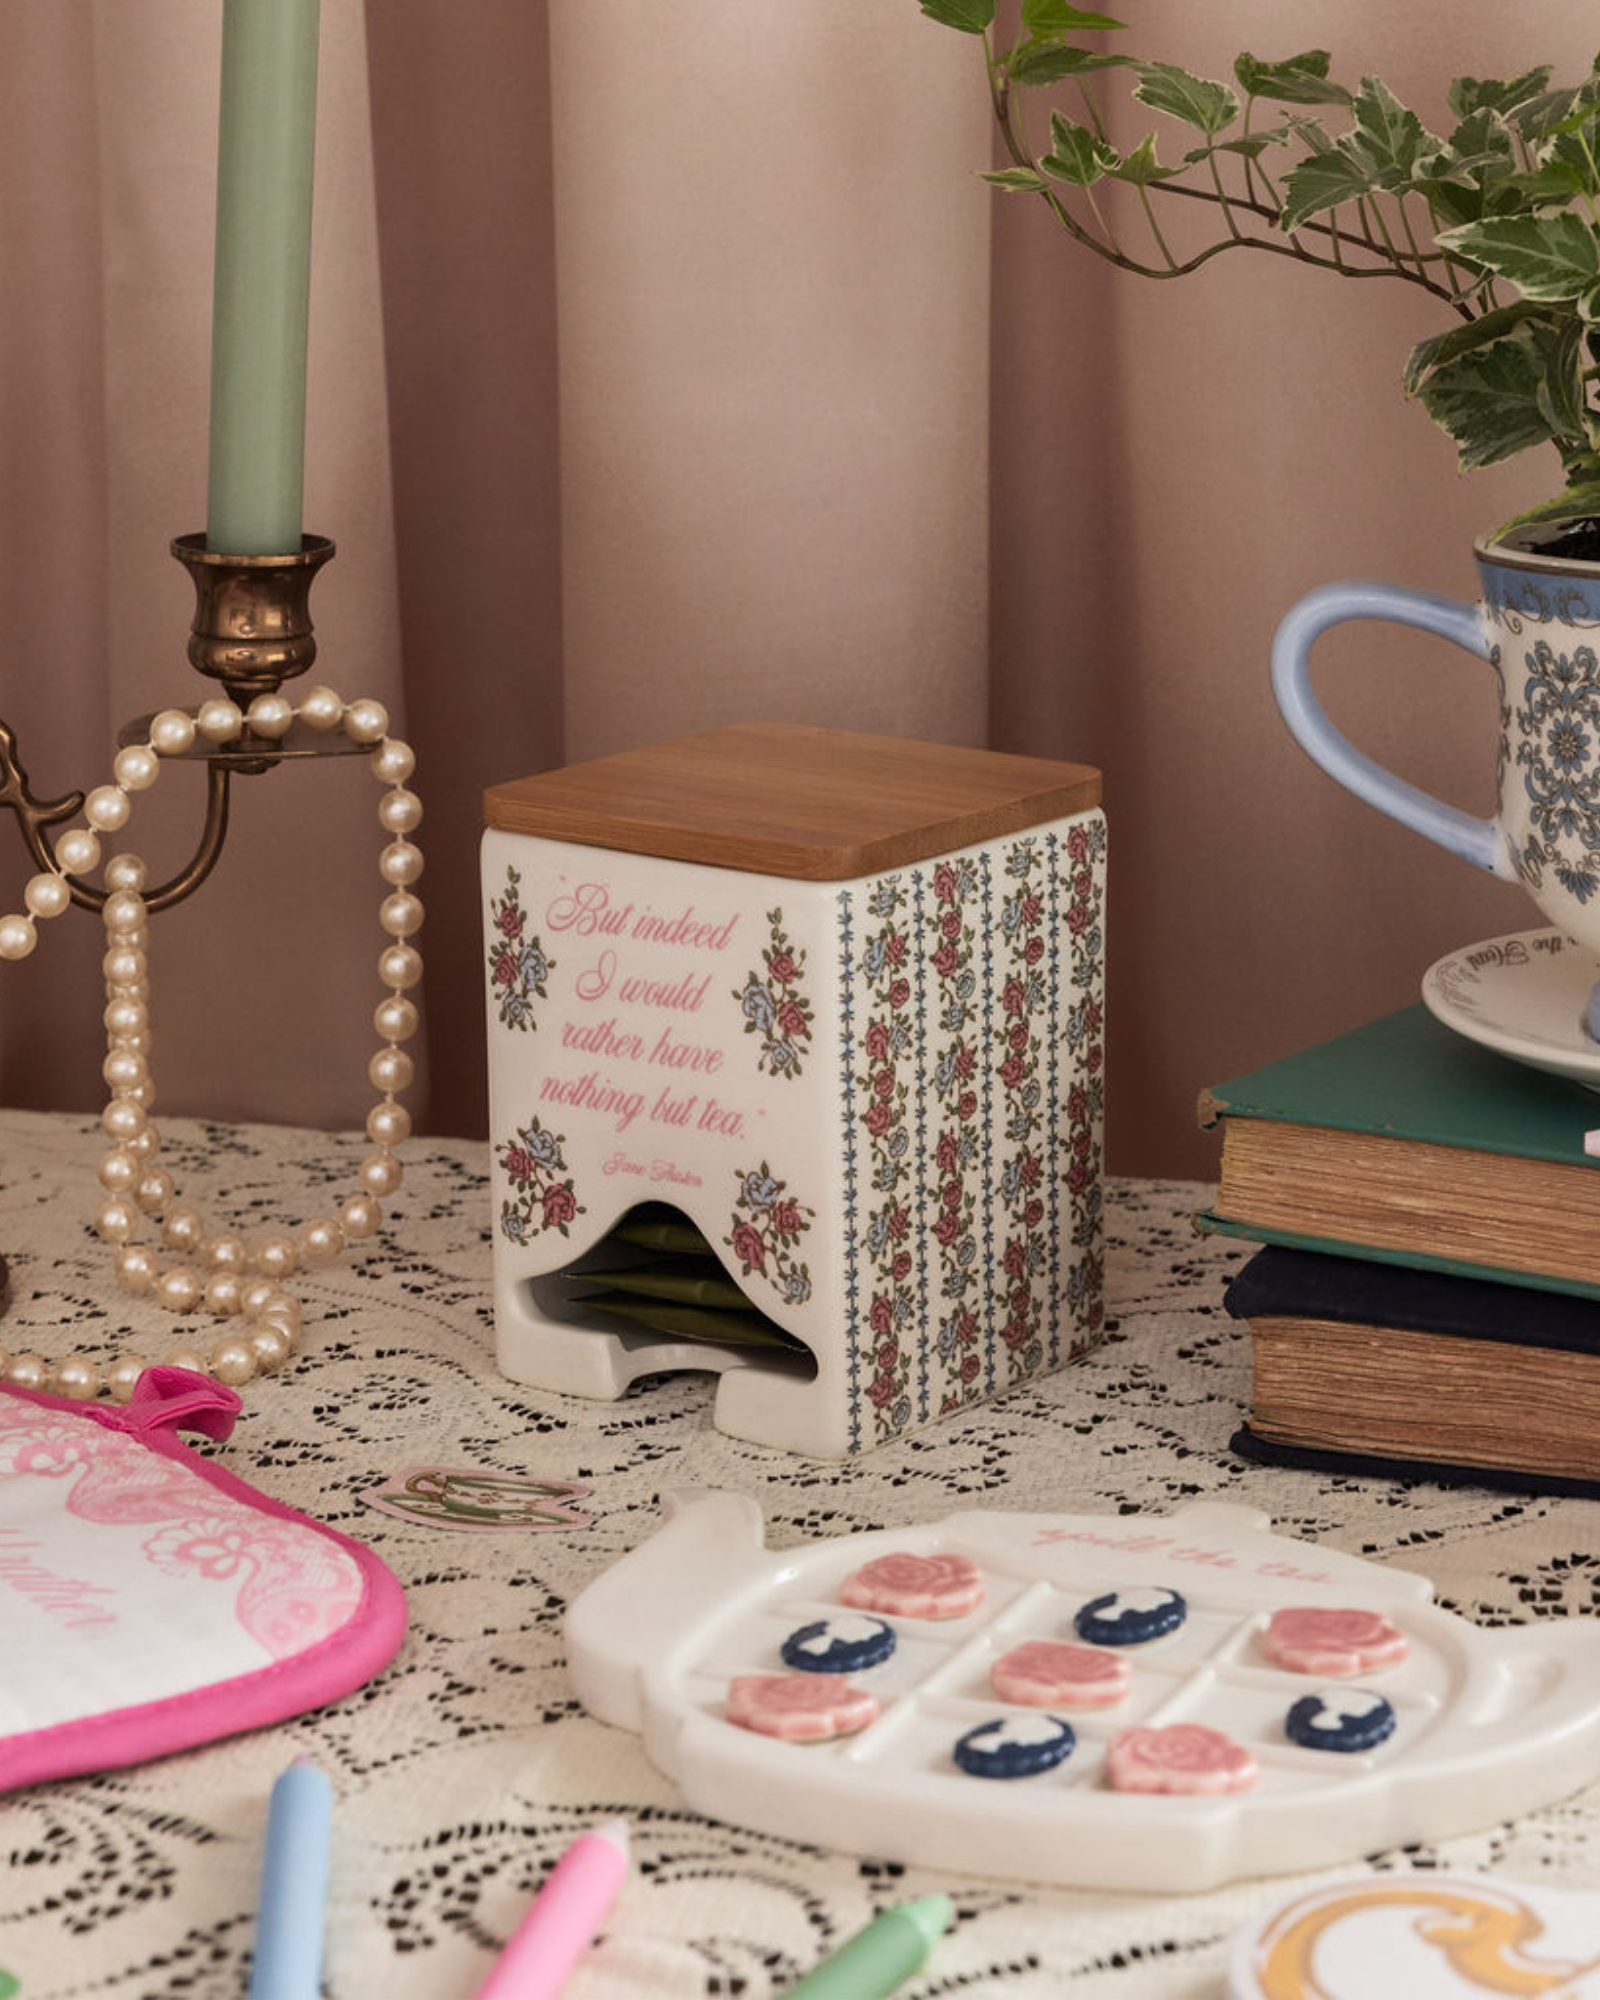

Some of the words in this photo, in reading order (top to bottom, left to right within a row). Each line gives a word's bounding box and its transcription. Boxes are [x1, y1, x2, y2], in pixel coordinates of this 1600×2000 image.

[633, 907, 740, 950] indeed
[575, 950, 617, 1002] I
[619, 972, 713, 1013] would
[562, 1018, 643, 1064] rather
[649, 1027, 724, 1074] have
[538, 1073, 645, 1133] nothing
[650, 1087, 695, 1126] but
